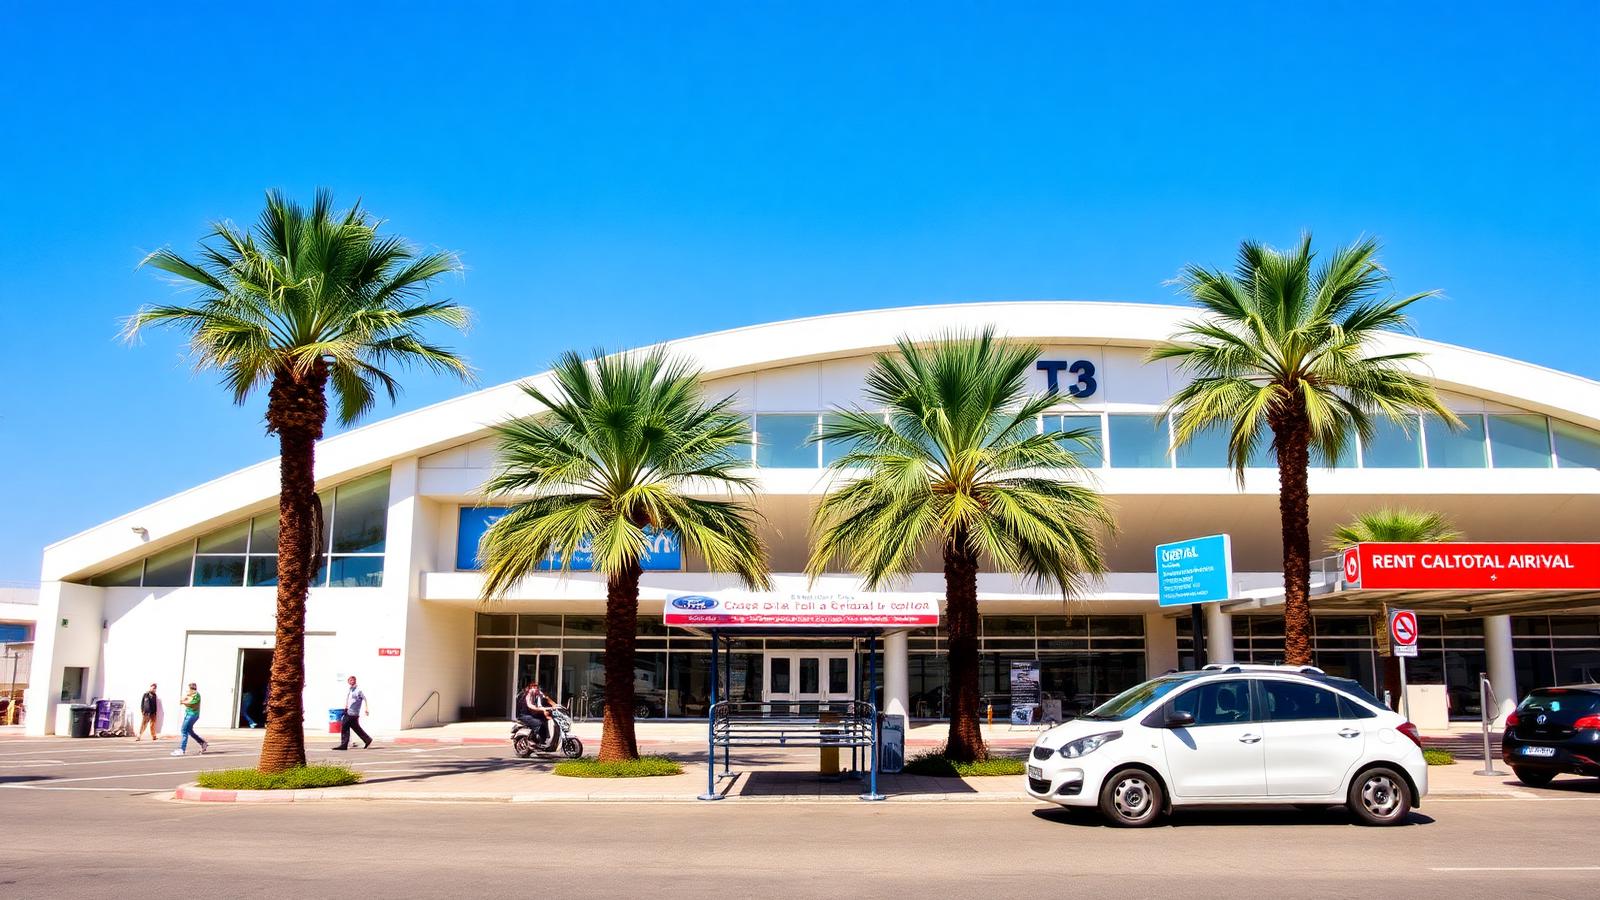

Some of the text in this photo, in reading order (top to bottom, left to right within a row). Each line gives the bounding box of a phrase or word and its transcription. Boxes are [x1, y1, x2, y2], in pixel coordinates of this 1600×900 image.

[1036, 360, 1097, 398] T3
[1372, 554, 1416, 569] RENT
[1420, 554, 1505, 569] CALTOTAL
